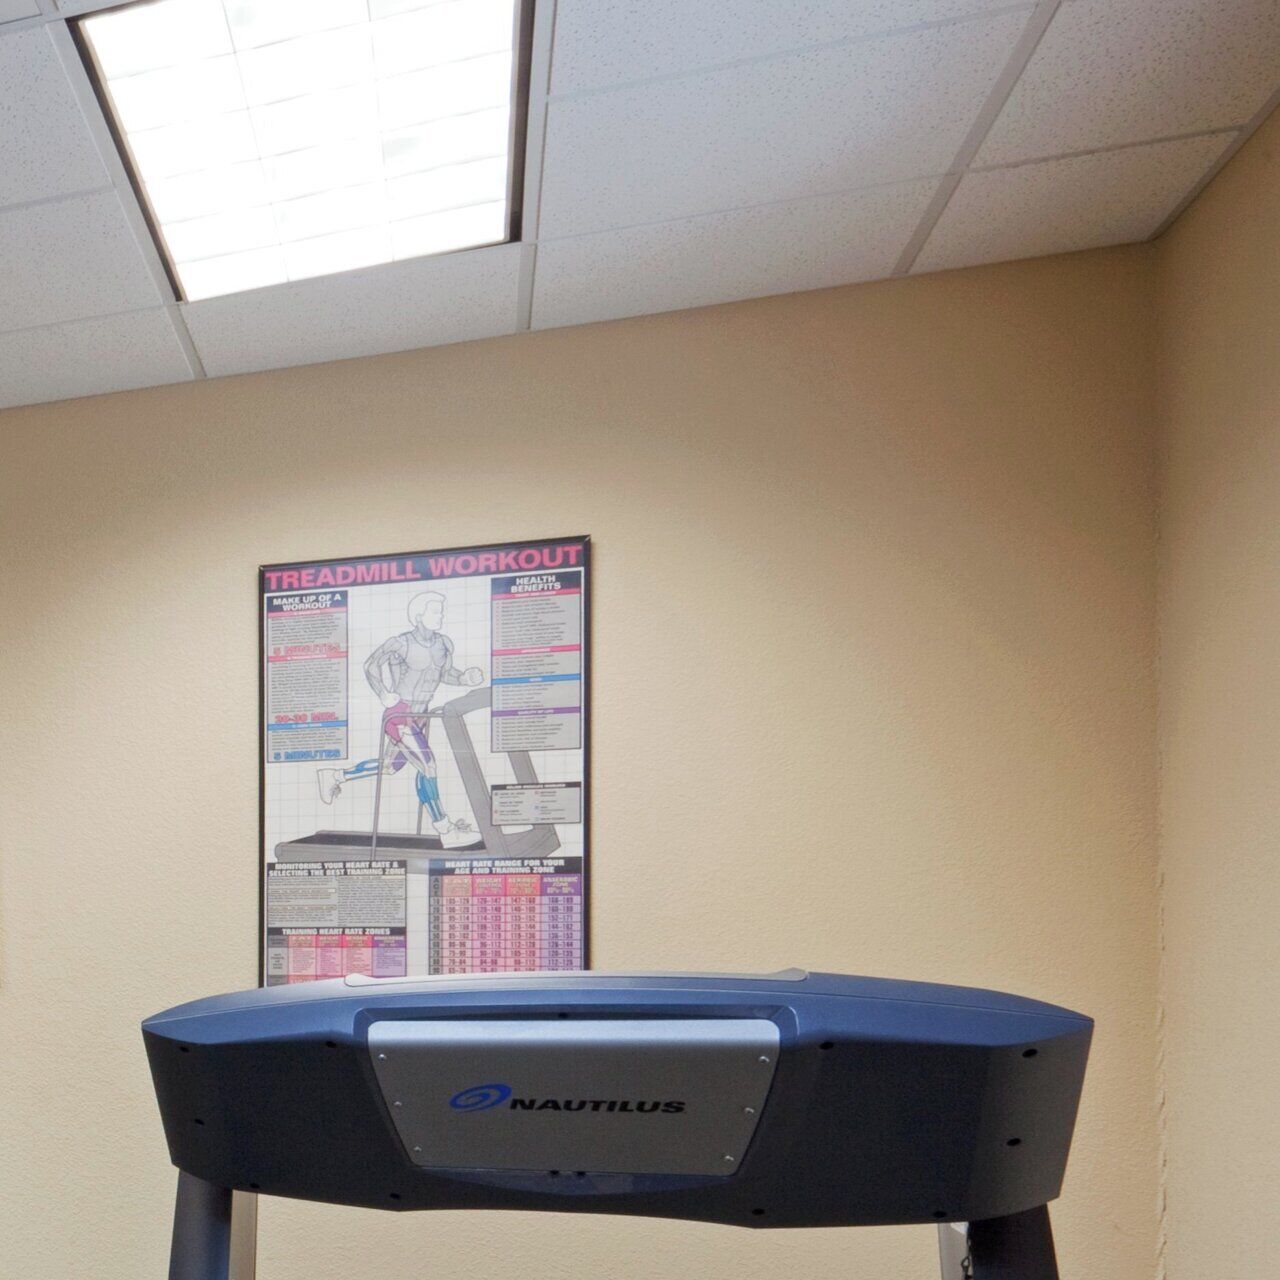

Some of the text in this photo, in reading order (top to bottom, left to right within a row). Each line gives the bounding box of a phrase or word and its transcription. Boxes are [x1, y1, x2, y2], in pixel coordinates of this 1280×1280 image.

[265, 545, 582, 590] TREADMILL WORKOUT
[516, 575, 556, 585] HEALTH
[511, 582, 561, 593] BENEFITS
[273, 597, 300, 605] MAKE
[302, 595, 316, 603] UP
[283, 601, 332, 611] WORKOUT
[275, 862, 322, 870] MONITORING
[473, 860, 492, 868] RATE
[346, 868, 383, 876] TRAINING
[385, 867, 406, 875] ZONE
[454, 867, 470, 875] AGE
[365, 927, 391, 935] ZONES
[509, 1098, 687, 1114] NAUTILUS
